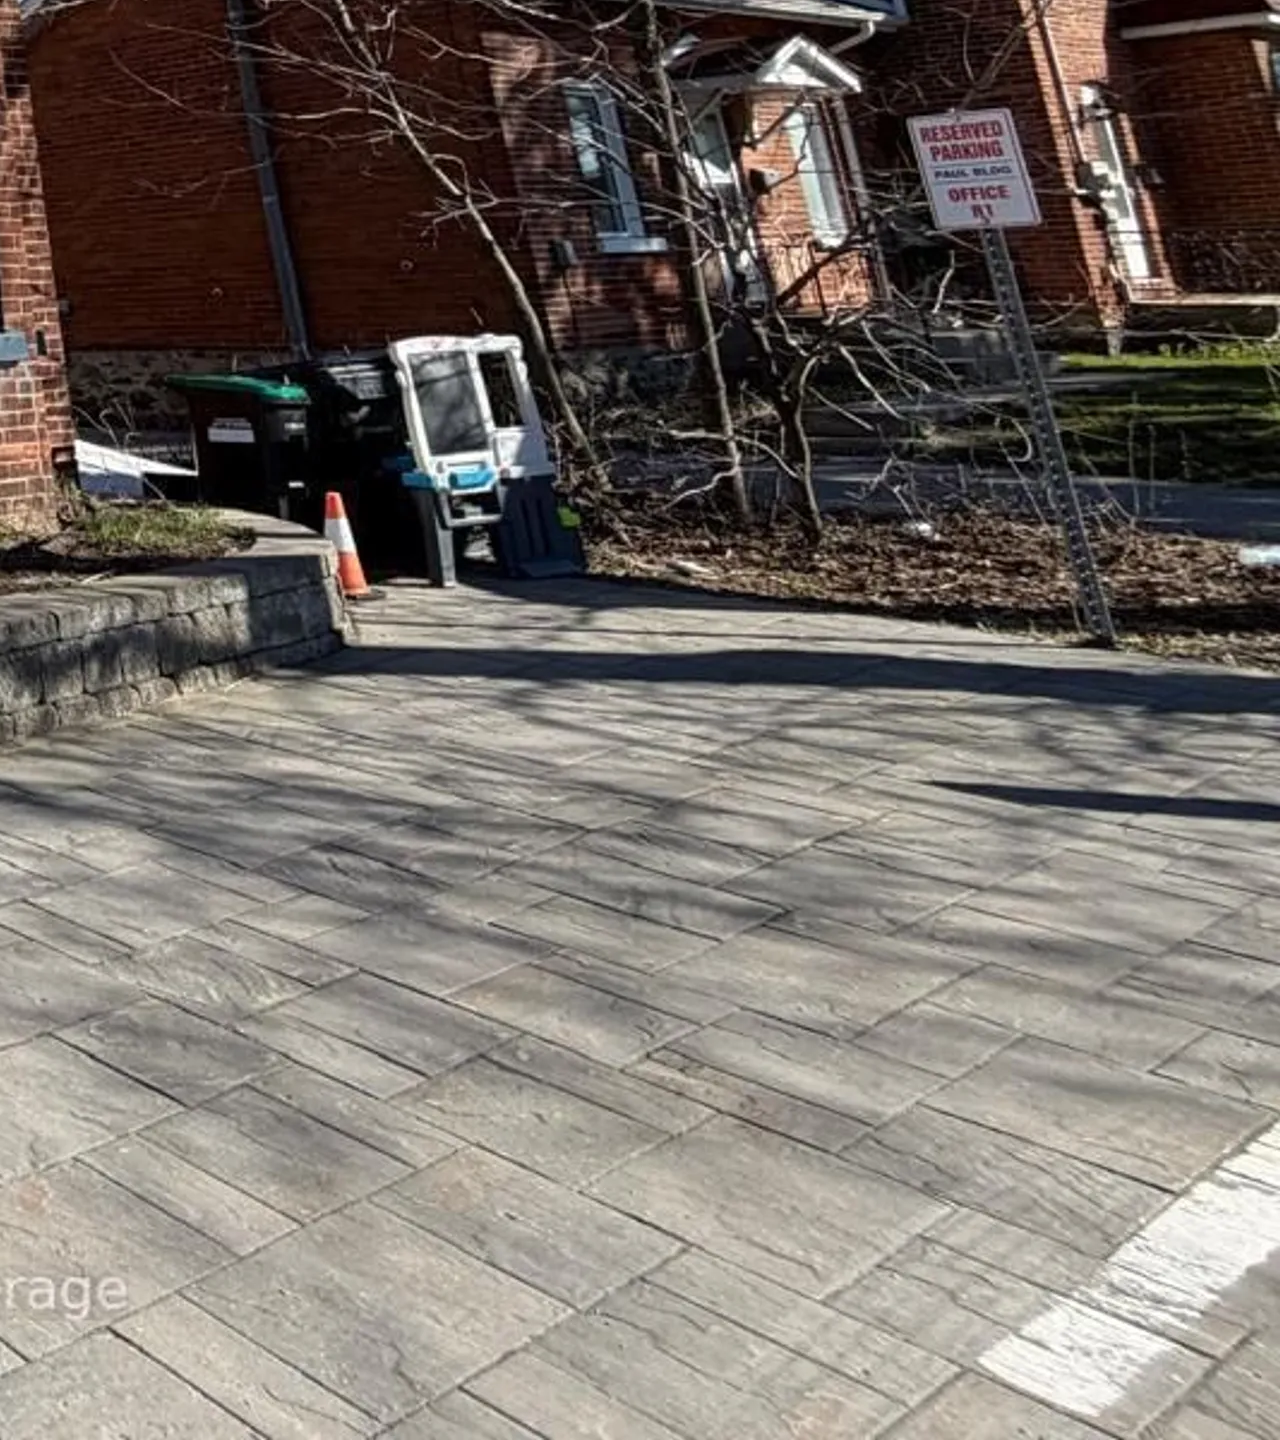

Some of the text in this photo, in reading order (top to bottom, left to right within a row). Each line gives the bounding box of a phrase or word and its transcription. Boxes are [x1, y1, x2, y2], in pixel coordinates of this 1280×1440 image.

[920, 120, 1003, 144] RESERVED
[930, 139, 1003, 162] PARKING
[947, 185, 1011, 203] OFFICE
